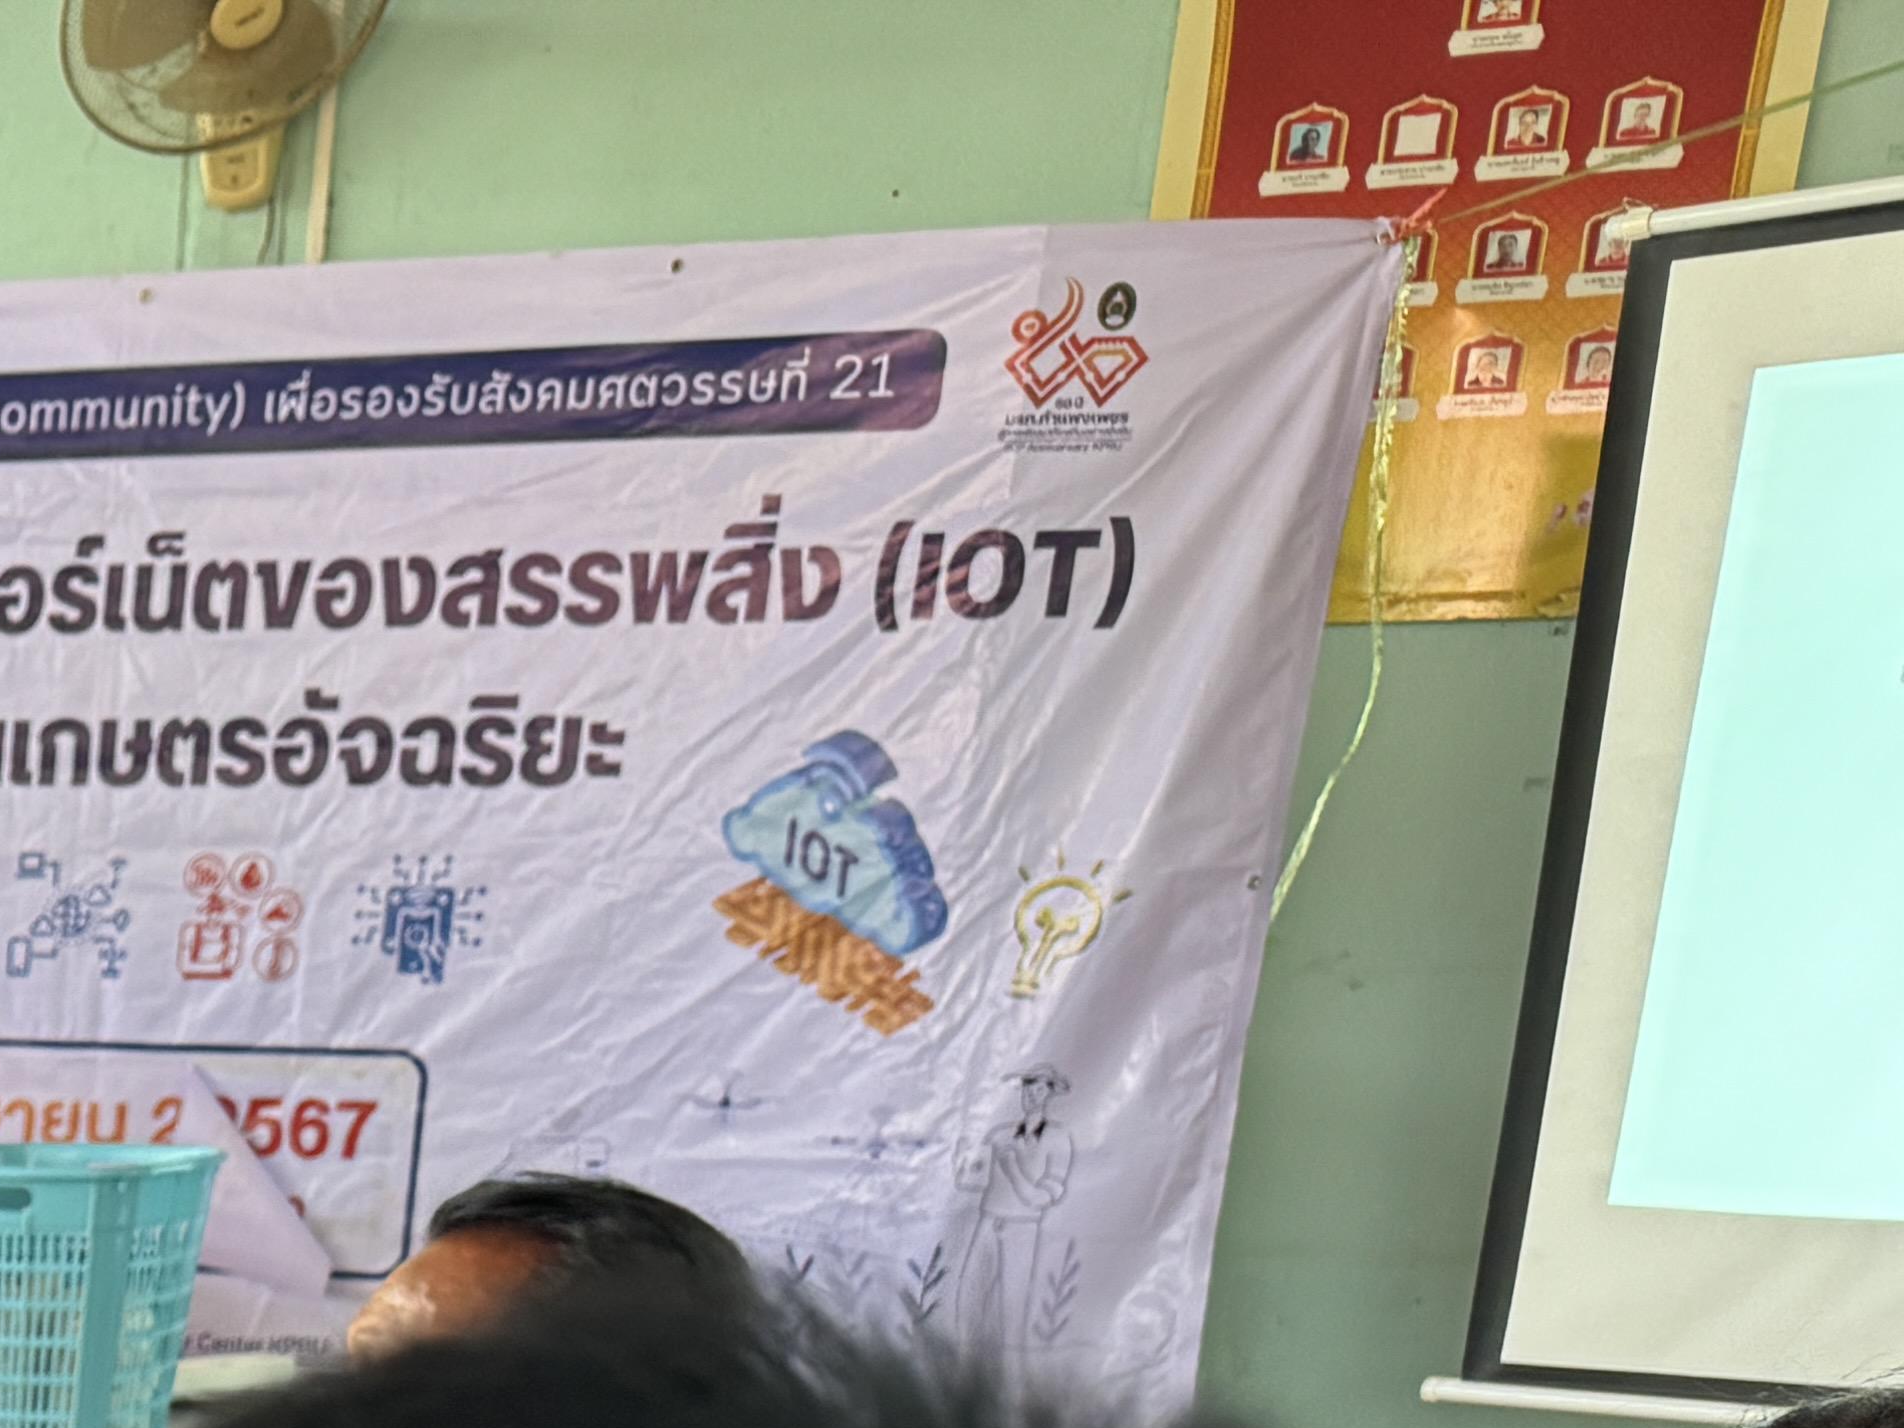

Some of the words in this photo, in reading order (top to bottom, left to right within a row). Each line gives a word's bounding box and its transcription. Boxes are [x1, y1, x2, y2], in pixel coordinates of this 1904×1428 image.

[829, 351, 895, 400] 21
[874, 516, 1135, 632] (IOT)
[783, 818, 859, 897] IOT
[214, 1094, 378, 1160] 567
